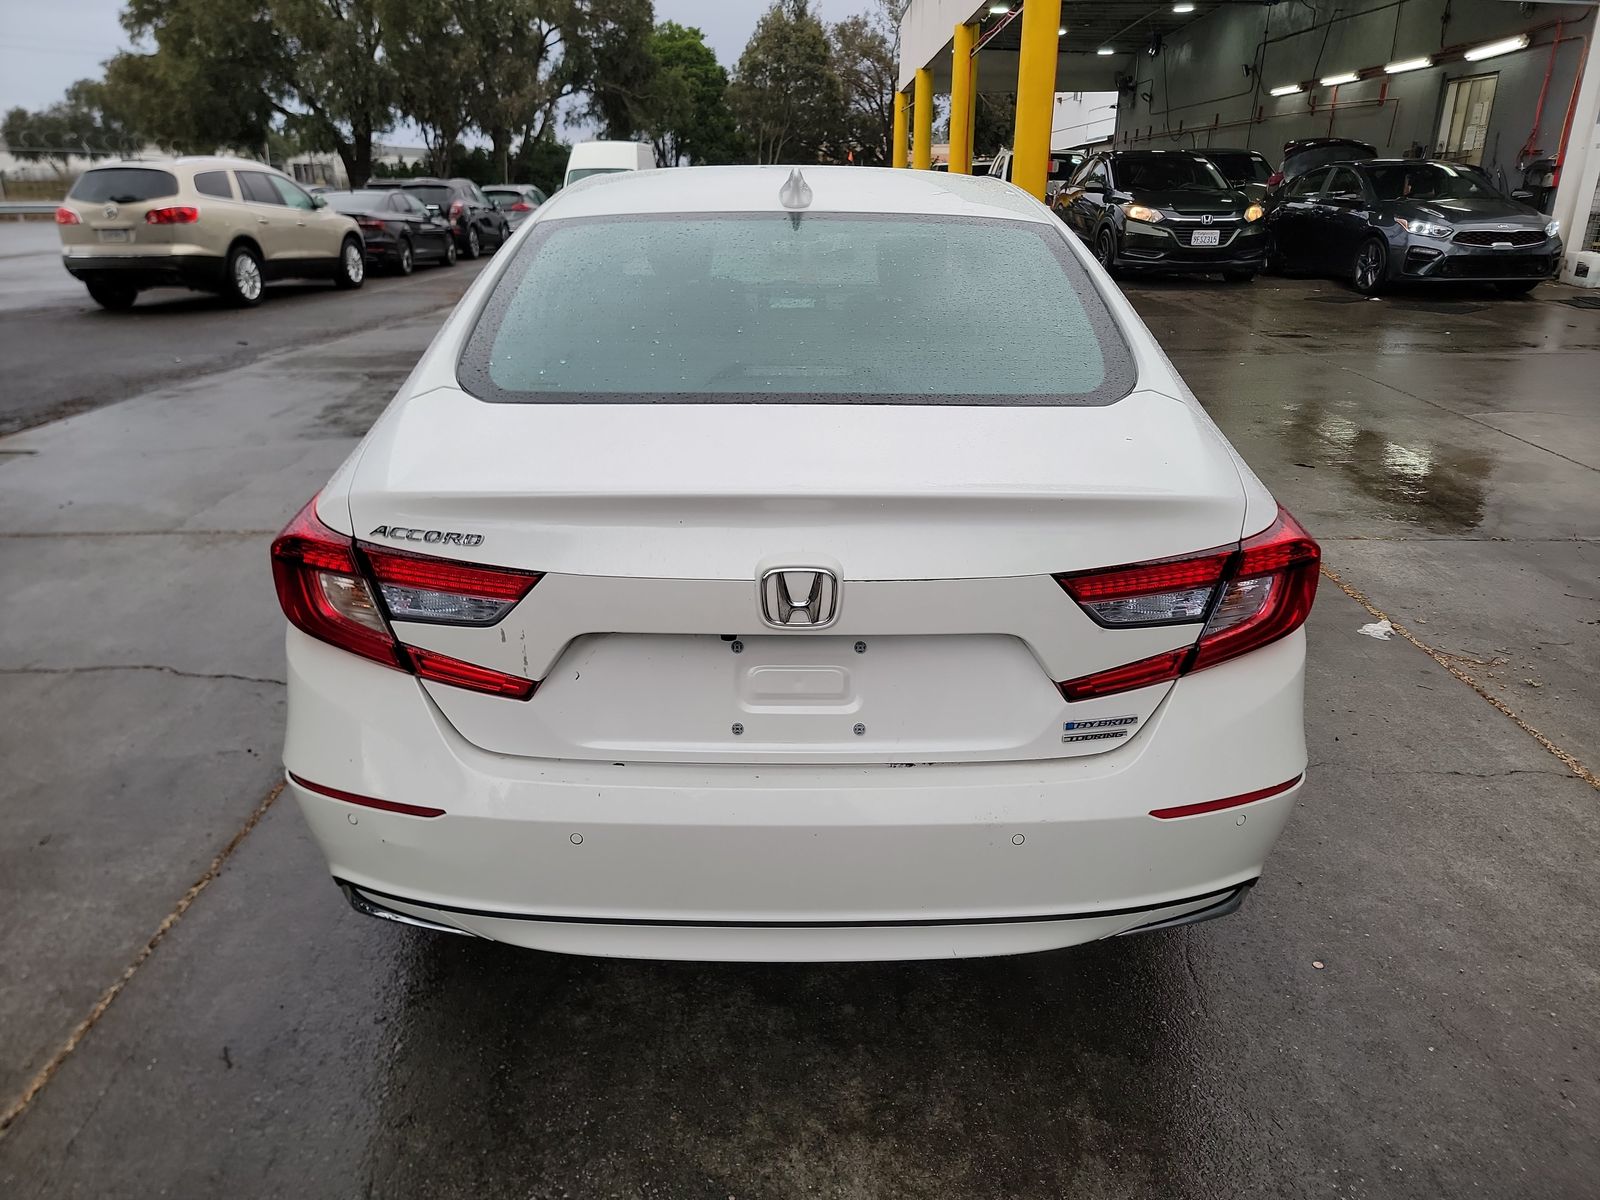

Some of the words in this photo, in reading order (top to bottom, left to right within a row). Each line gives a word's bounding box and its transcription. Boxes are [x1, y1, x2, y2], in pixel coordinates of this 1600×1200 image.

[369, 525, 485, 547] ACCORD
[1073, 717, 1134, 729] HYBRID
[1070, 732, 1124, 742] TOURING
